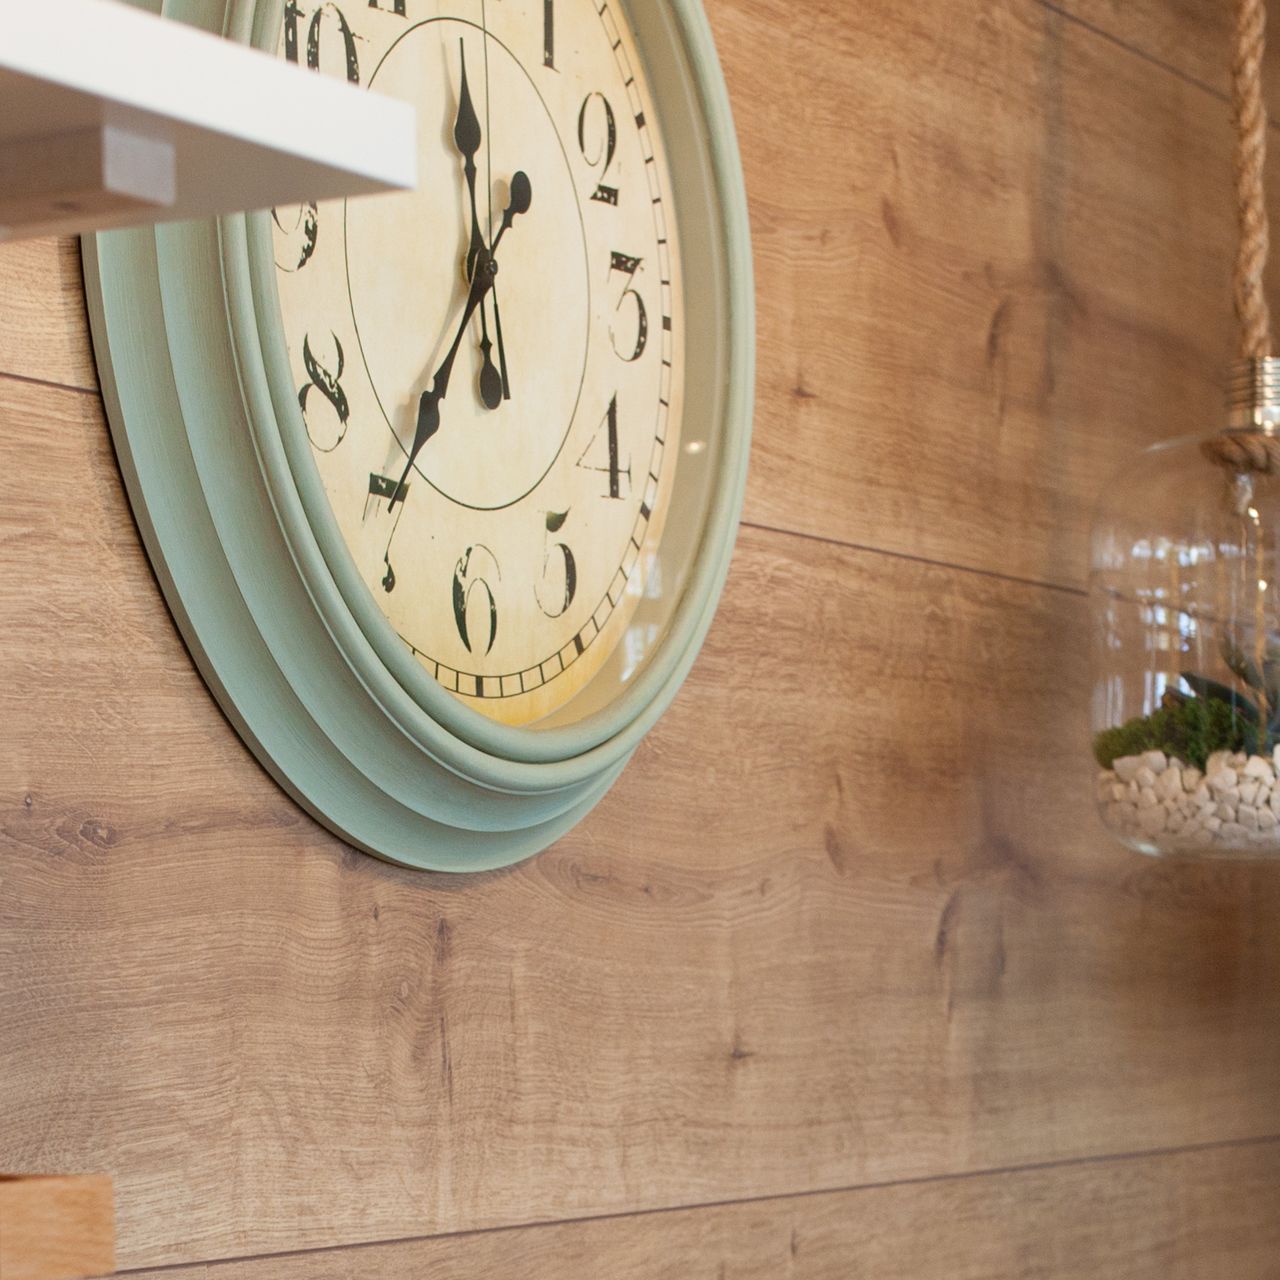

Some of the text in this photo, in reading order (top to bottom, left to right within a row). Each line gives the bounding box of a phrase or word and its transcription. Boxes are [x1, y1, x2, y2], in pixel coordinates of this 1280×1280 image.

[578, 92, 619, 206] 2
[607, 251, 648, 362] 3
[298, 329, 350, 453] 8
[576, 389, 633, 500] 4
[452, 543, 501, 657] 6
[533, 506, 577, 619] 5
